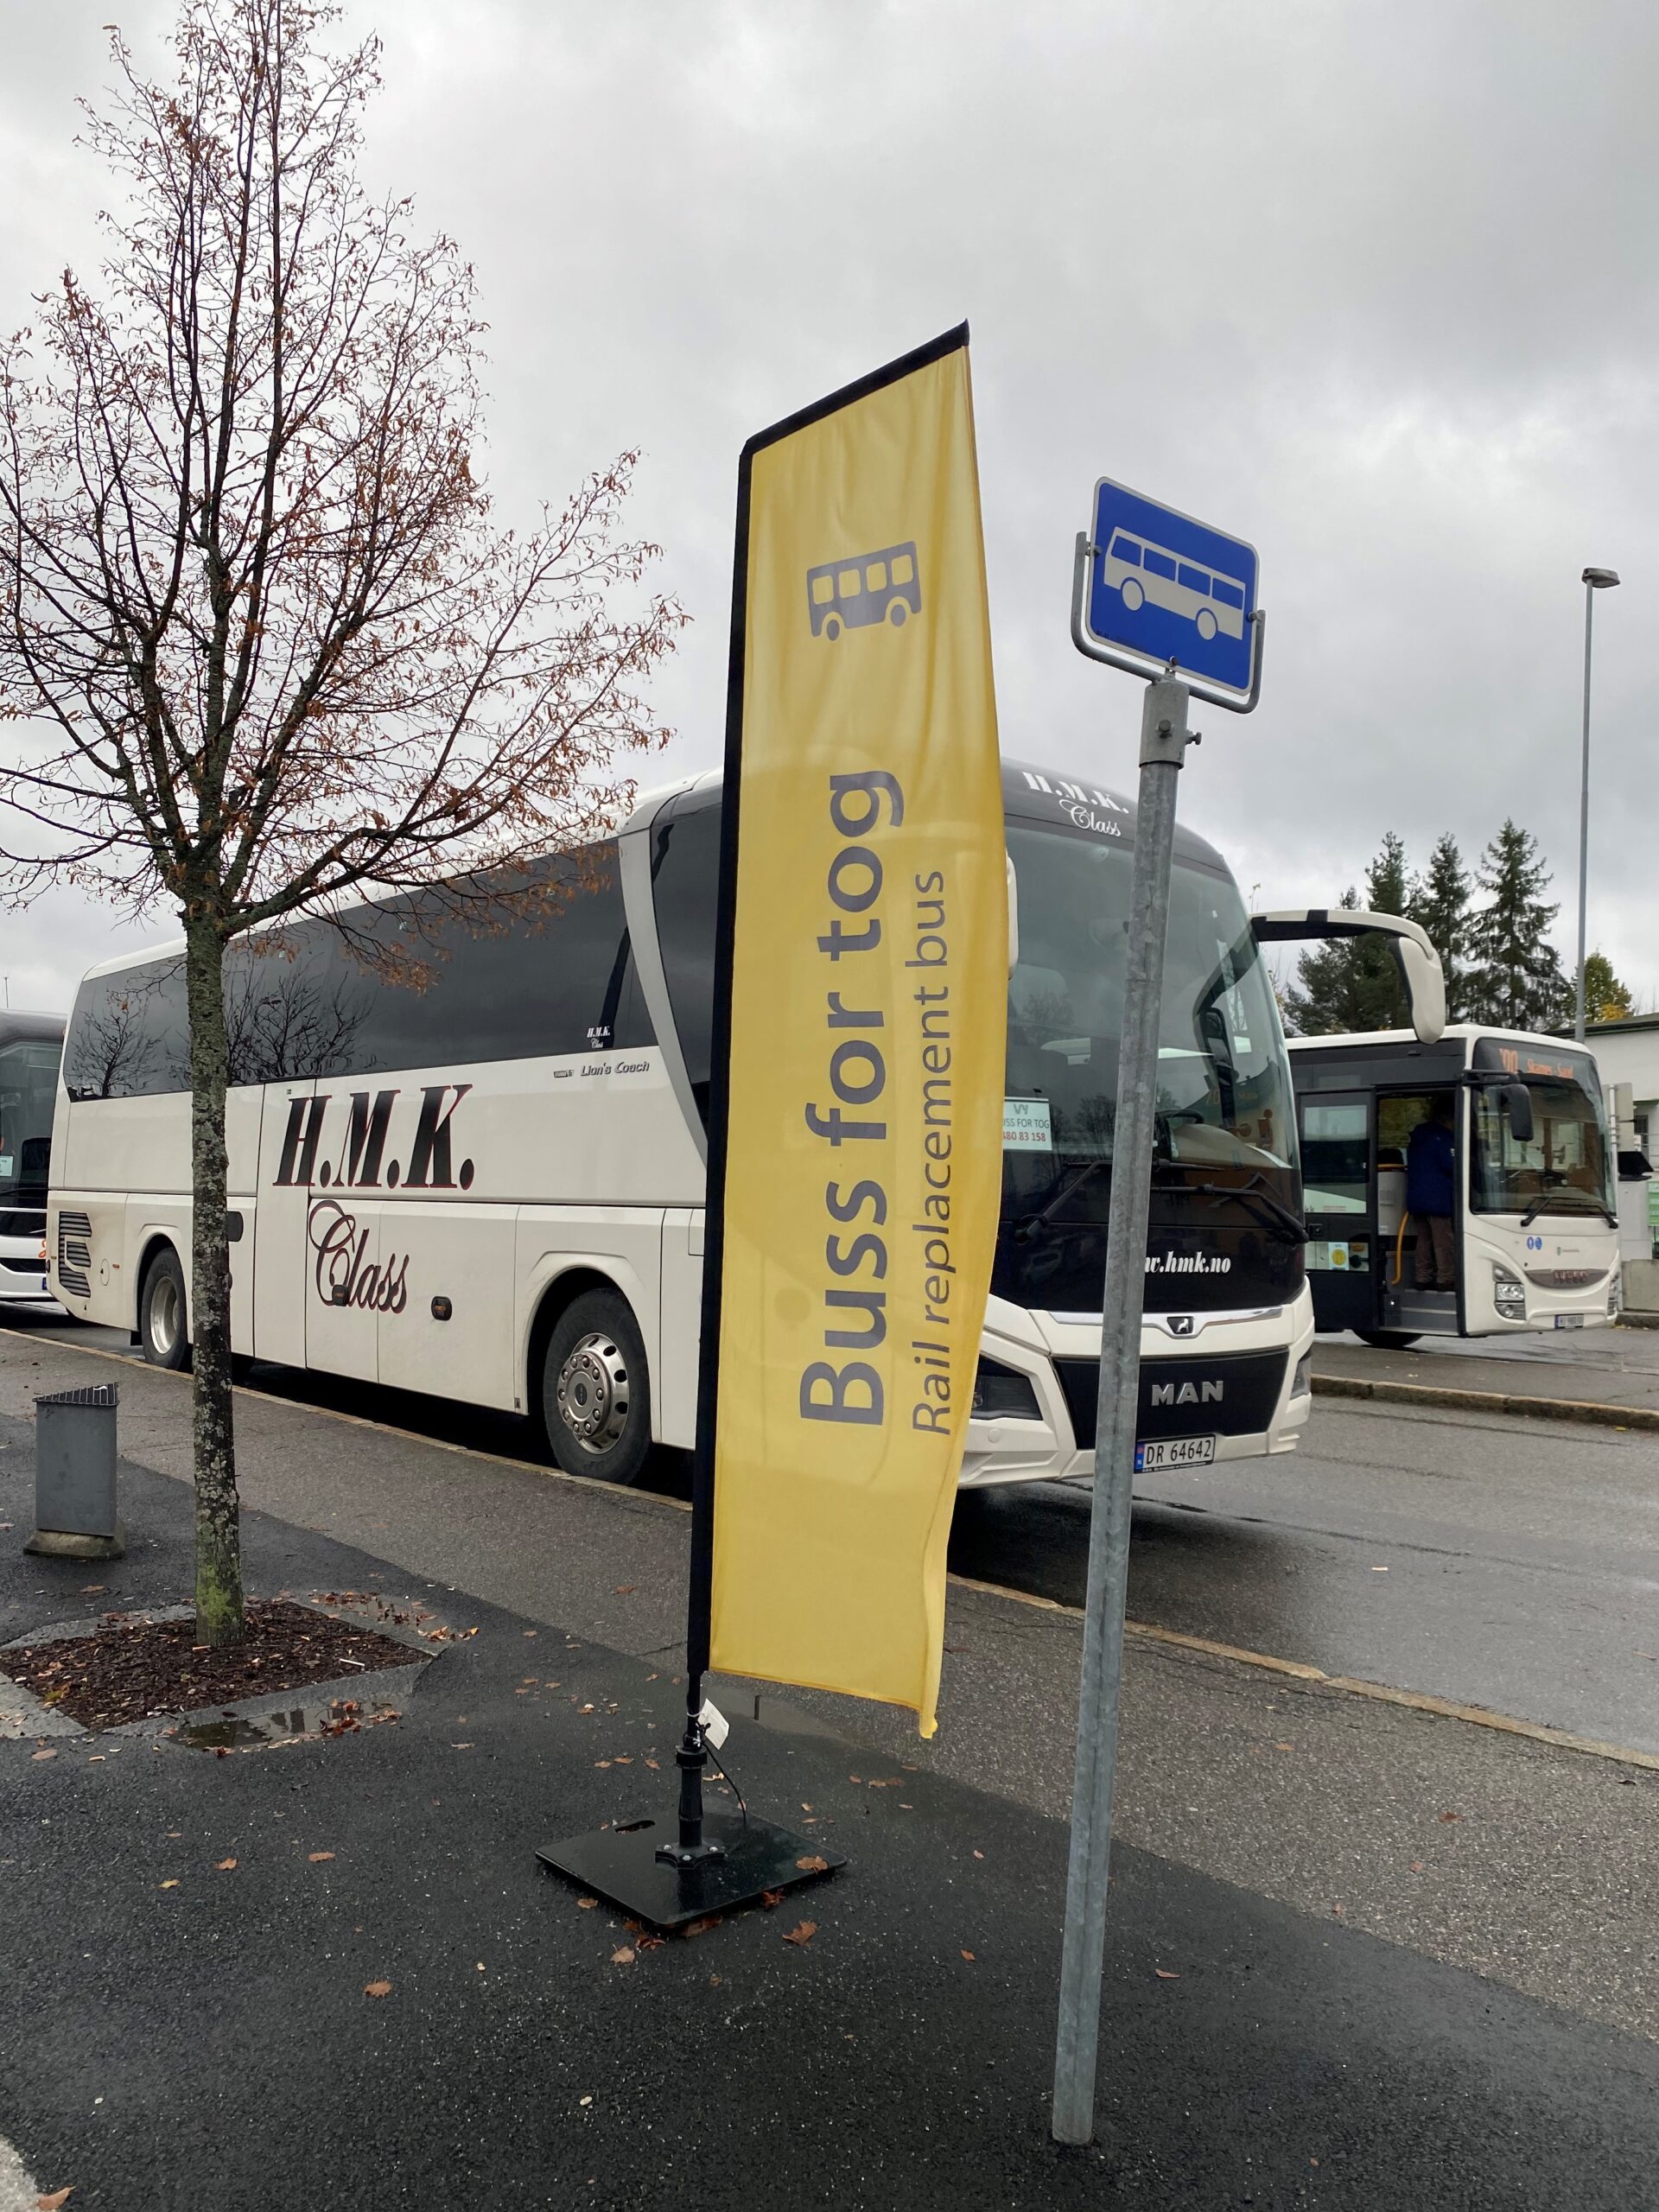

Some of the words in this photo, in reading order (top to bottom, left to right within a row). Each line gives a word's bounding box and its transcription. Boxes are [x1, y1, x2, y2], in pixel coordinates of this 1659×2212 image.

[1022, 771, 1129, 814] H.M.K.
[1058, 798, 1122, 836] Class
[817, 770, 905, 962] tog
[905, 871, 948, 967] bus
[587, 1026, 611, 1038] H.M.K.
[581, 1062, 612, 1077] Lion's
[614, 1061, 650, 1073] Coach
[805, 992, 887, 1147] for
[272, 1084, 475, 1191] H.M.K.
[912, 986, 957, 1325] replacement
[1017, 1118, 1033, 1128] FOR
[1033, 1119, 1050, 1128] TOG
[1019, 1132, 1028, 1141] 83
[1032, 1132, 1046, 1141] 158
[308, 1199, 410, 1314] Class
[799, 1180, 887, 1426] Buss
[912, 1341, 951, 1435] Rail
[1151, 1380, 1224, 1407] MAN
[1146, 1445, 1165, 1465] DR
[1170, 1440, 1211, 1462] 64642
